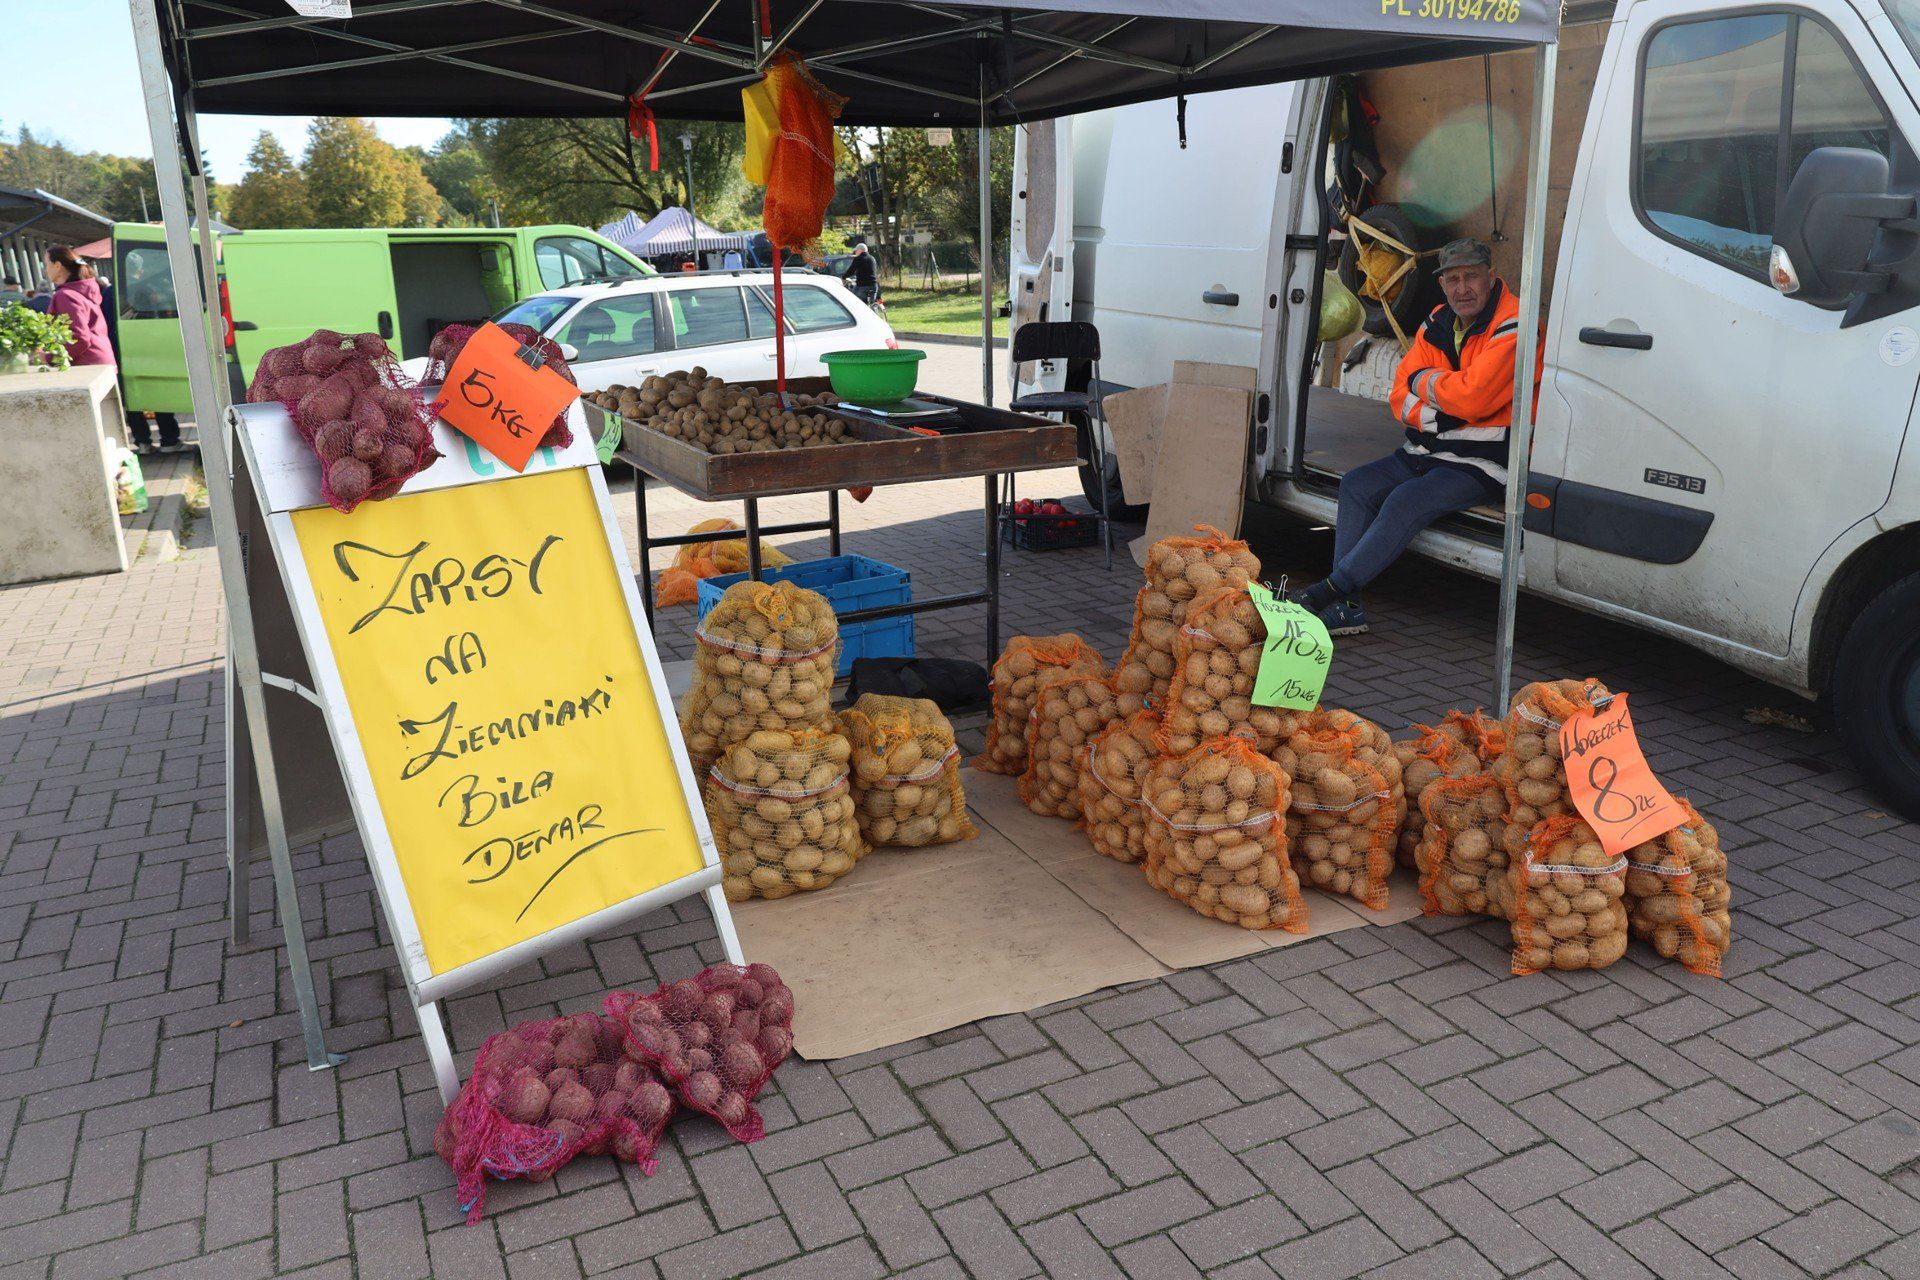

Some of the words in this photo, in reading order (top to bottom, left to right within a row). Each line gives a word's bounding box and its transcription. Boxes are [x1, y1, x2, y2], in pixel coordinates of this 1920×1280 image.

[1418, 0, 1520, 23] 30194786
[460, 368, 496, 408] 5
[1647, 470, 1702, 491] F35.13
[425, 631, 487, 685] NA
[1588, 755, 1637, 824] 8
[461, 803, 606, 884] DENAR
